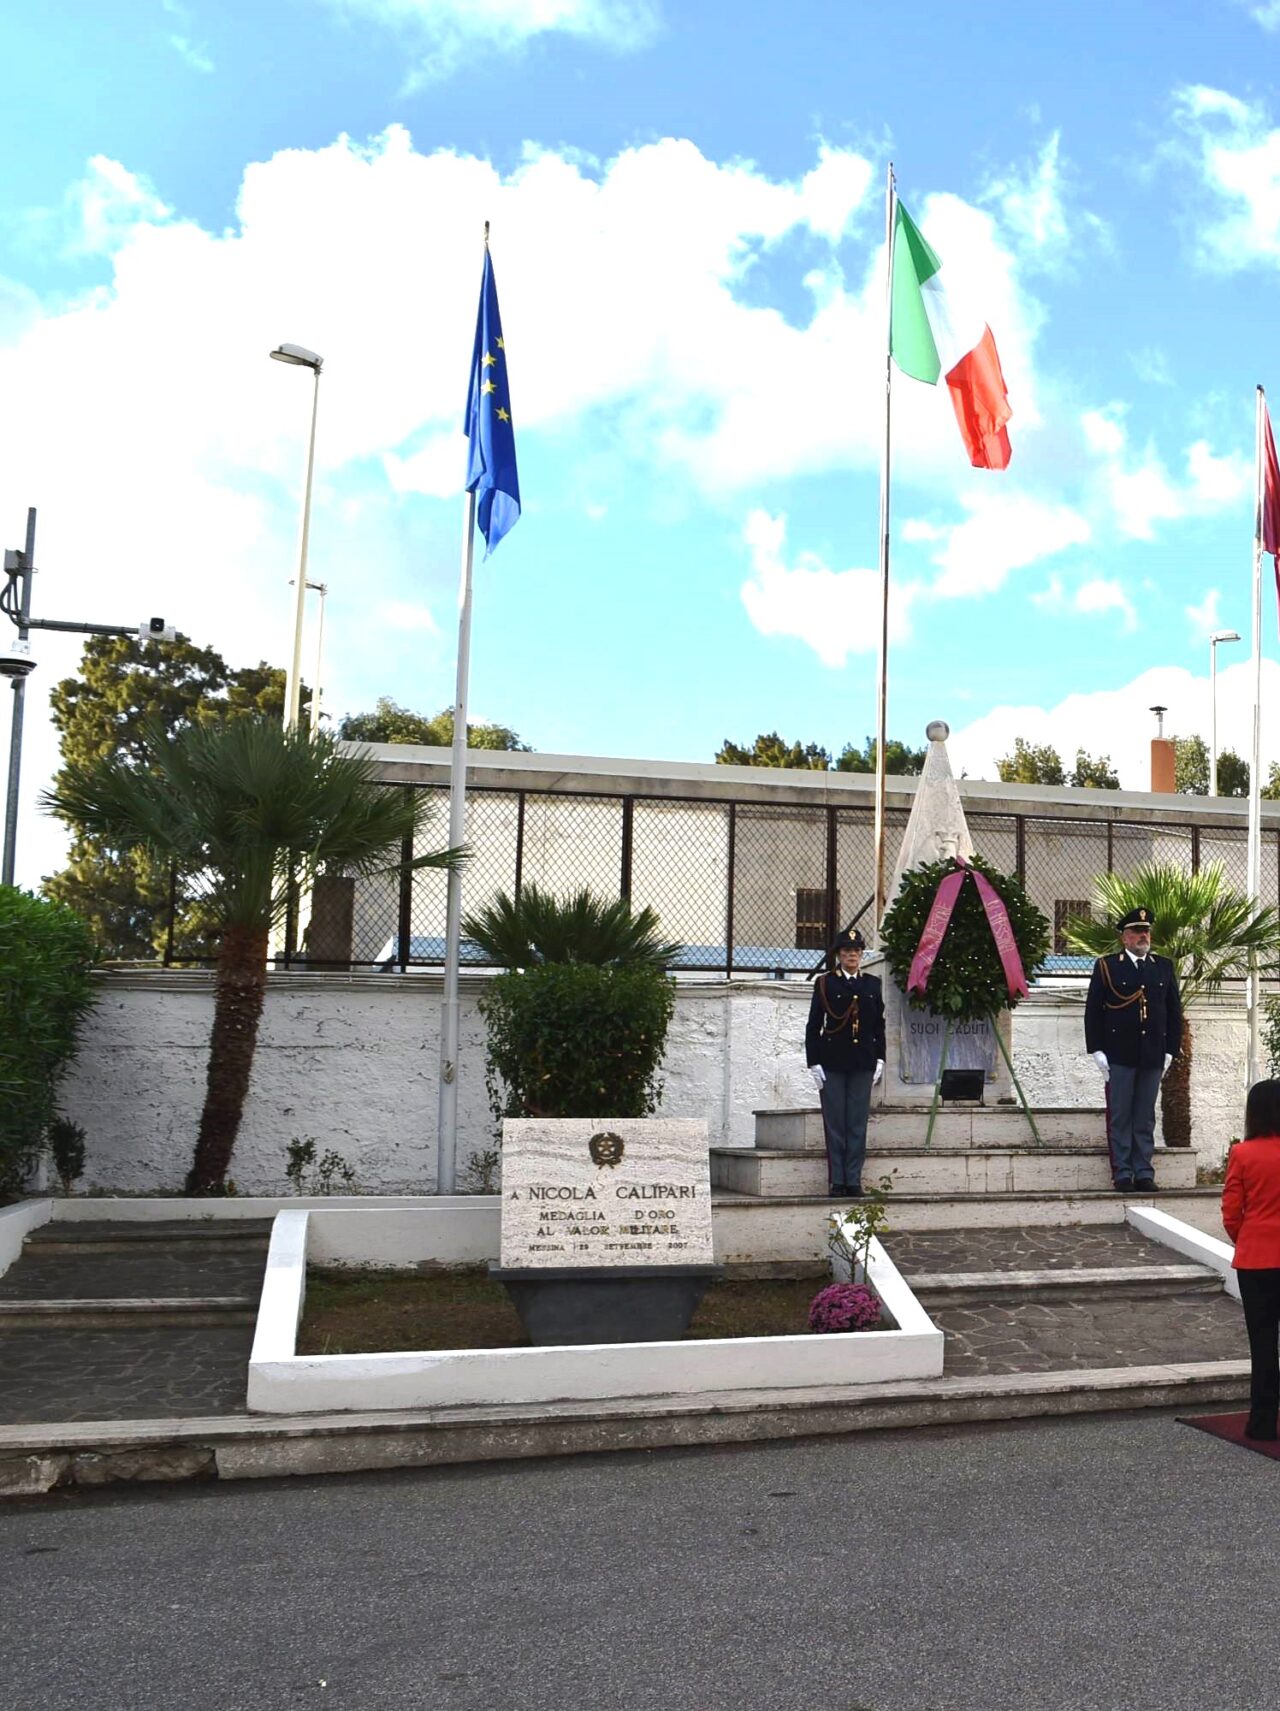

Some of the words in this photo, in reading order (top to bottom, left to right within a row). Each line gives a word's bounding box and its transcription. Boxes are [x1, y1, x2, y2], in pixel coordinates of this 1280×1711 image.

[910, 1023, 939, 1035] SUOI
[510, 1190, 520, 1200] A
[528, 1186, 598, 1201] NICOLA
[614, 1185, 697, 1200] CALIPARI
[538, 1210, 607, 1222] MEDAGLIA
[634, 1209, 677, 1221] D'ORO
[536, 1226, 556, 1237] AL
[567, 1225, 611, 1237] VALOR
[618, 1224, 680, 1237] MILITARE
[528, 1243, 567, 1252] MESSINA
[604, 1241, 654, 1251] SETTEMBRE
[667, 1241, 689, 1250] 2007
